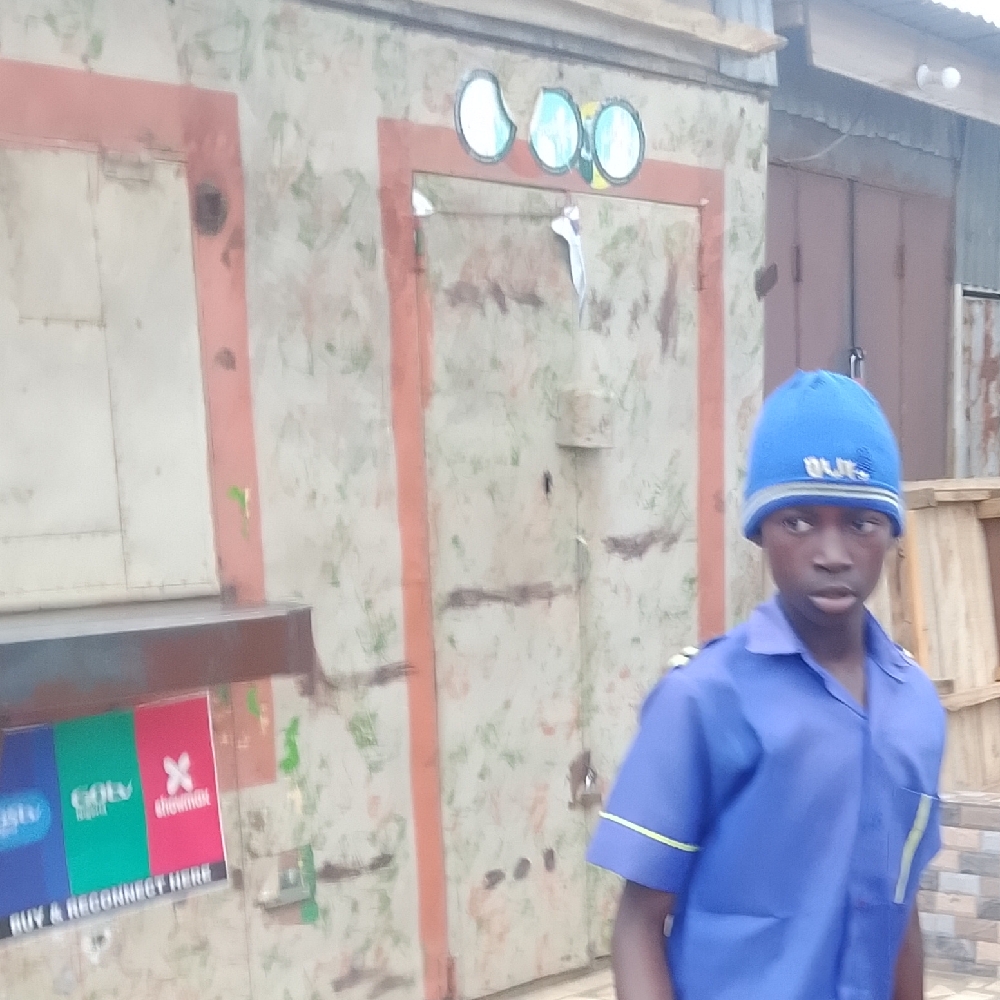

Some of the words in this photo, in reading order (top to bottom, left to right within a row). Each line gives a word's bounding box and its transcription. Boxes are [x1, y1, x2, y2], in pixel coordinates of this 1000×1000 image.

[10, 905, 44, 936] BUY
[50, 900, 64, 925] &
[66, 873, 165, 919] RECONNECT
[169, 863, 212, 891] HERE
